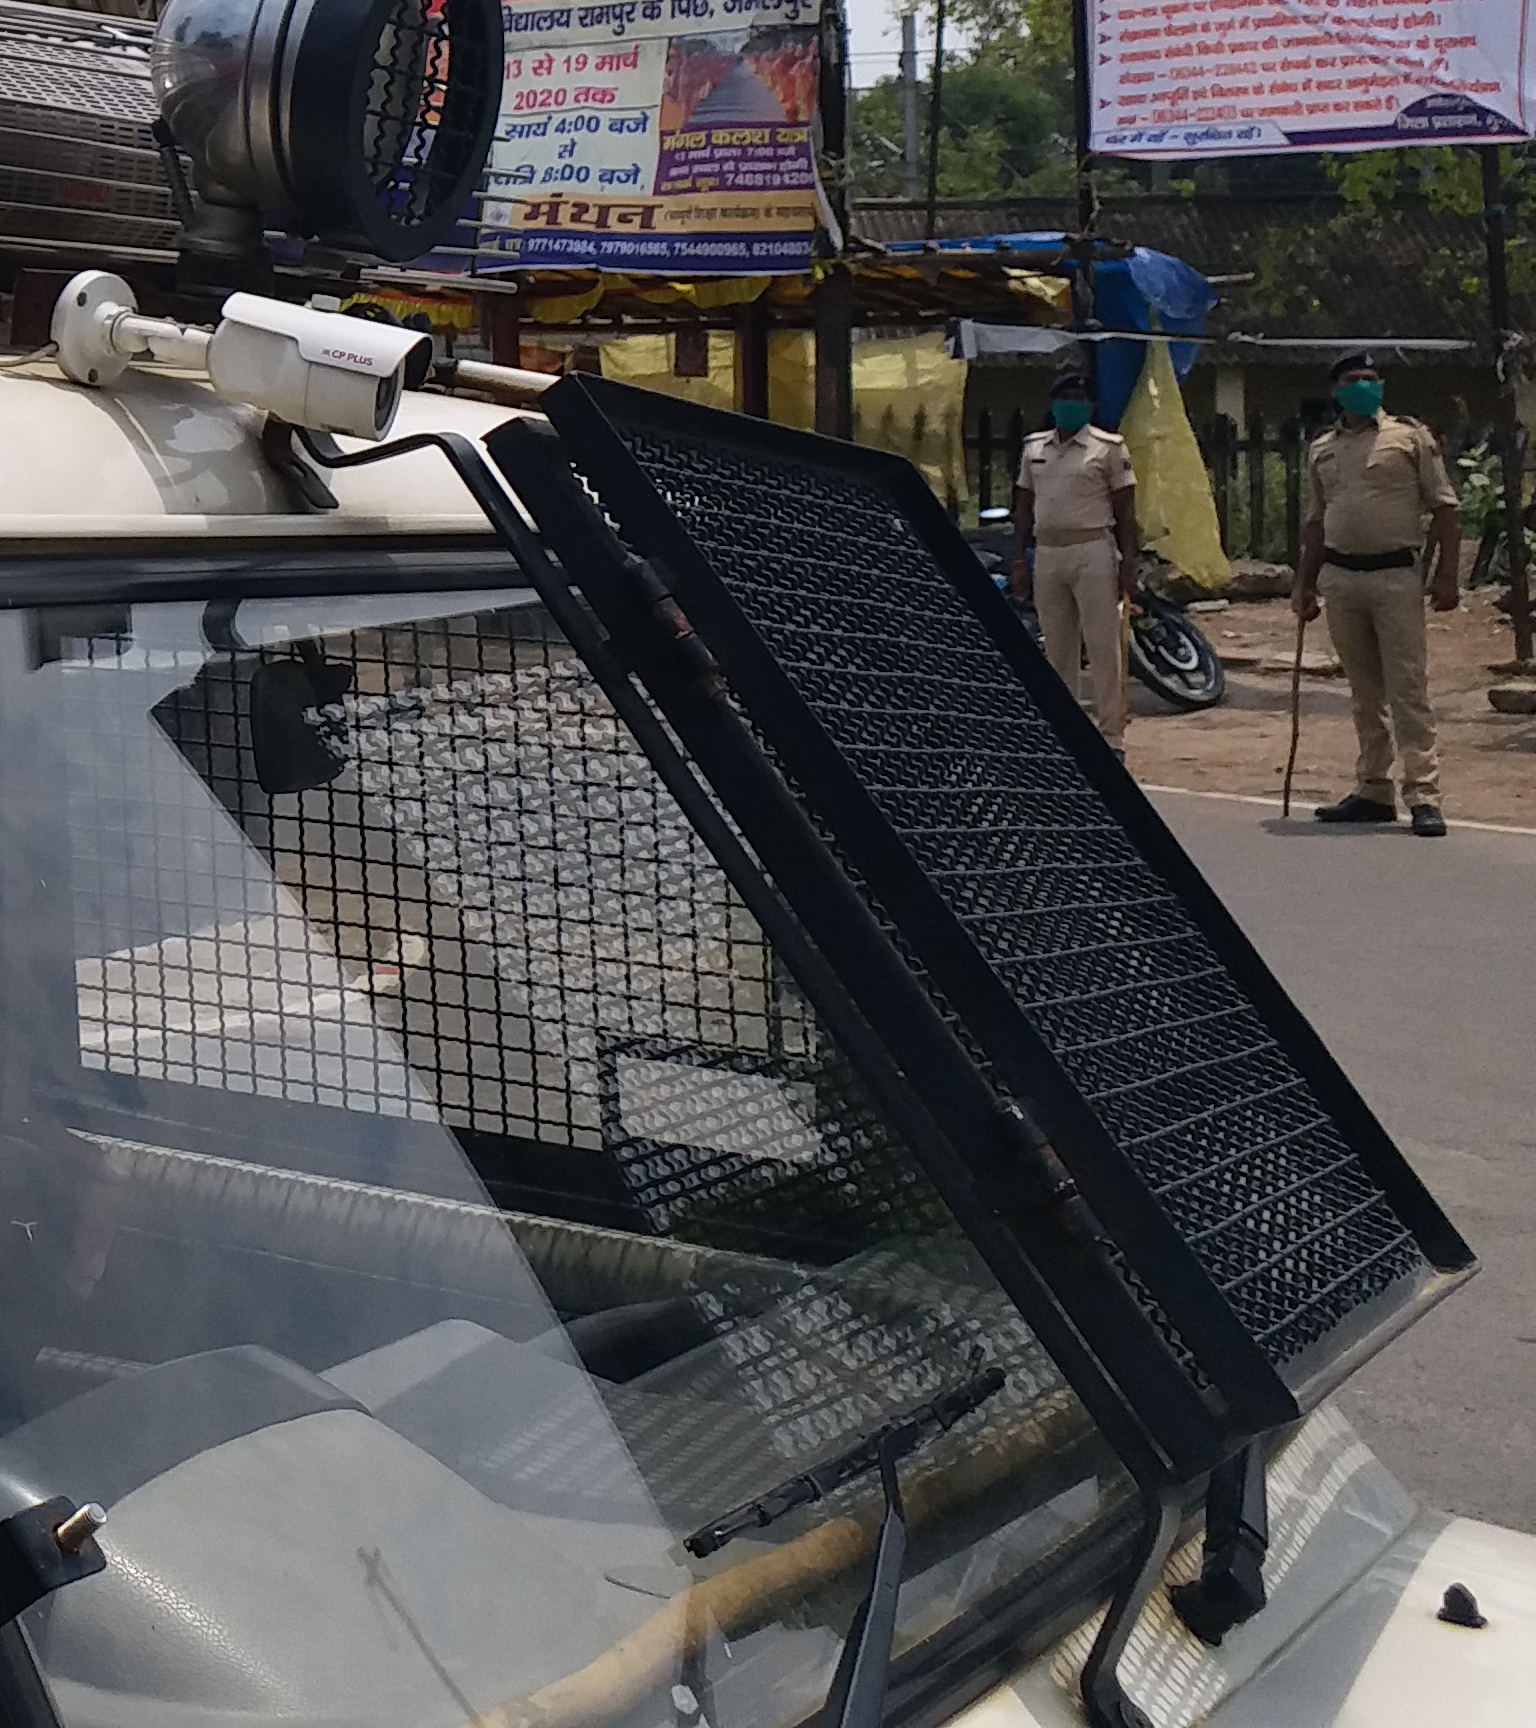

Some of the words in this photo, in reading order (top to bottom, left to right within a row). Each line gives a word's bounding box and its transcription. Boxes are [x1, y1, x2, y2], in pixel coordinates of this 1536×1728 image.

[578, 1, 635, 35] रामपुर
[504, 59, 522, 80] 13
[531, 53, 554, 76] से
[563, 54, 588, 72] 19
[595, 44, 640, 71] मार्च
[513, 89, 568, 112] 2020
[573, 86, 619, 105] तक
[554, 114, 599, 135] 4:00
[609, 112, 650, 134] बजे
[557, 139, 577, 159] से
[598, 165, 642, 185] बजे
[523, 193, 663, 229] मंथन
[331, 349, 346, 360] CP
[347, 353, 373, 366] PLUS
